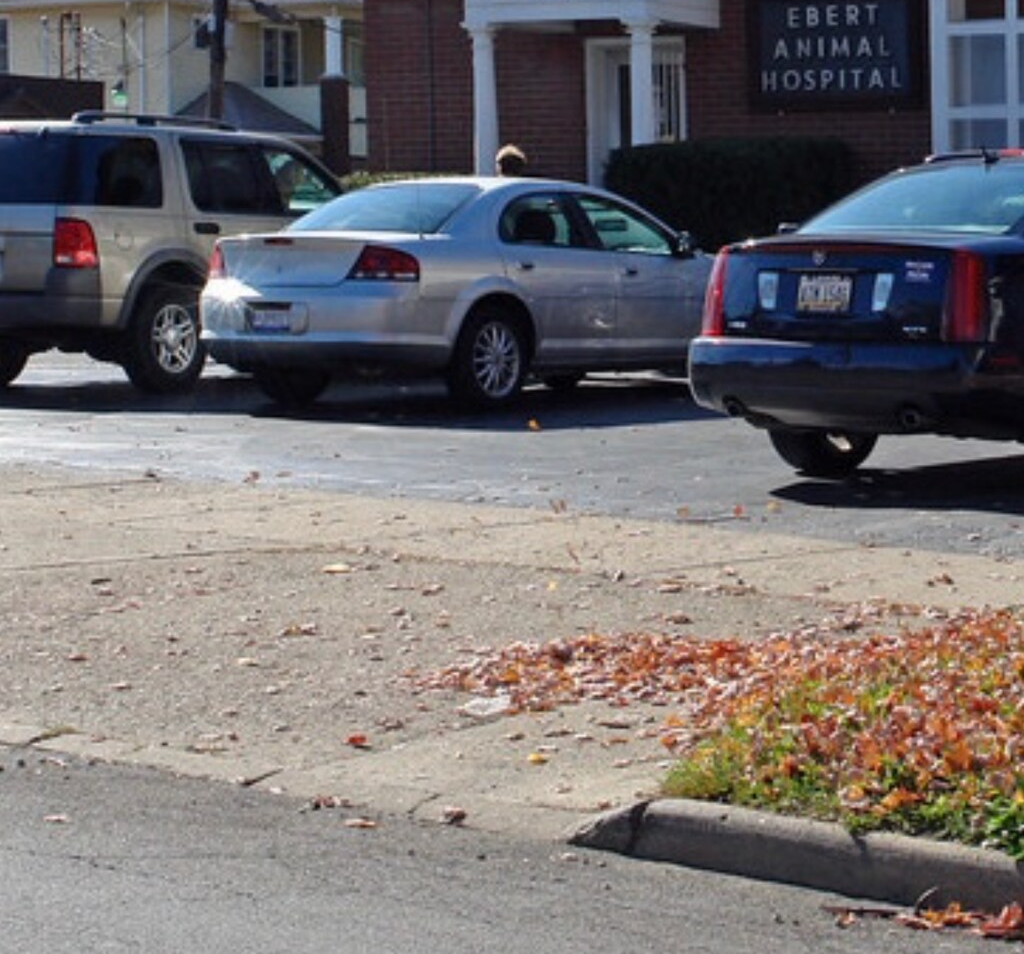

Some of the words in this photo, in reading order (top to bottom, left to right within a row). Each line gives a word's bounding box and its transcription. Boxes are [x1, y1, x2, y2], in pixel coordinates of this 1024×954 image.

[786, 4, 879, 29] EBERT
[773, 34, 891, 59] ANIMAL
[760, 66, 902, 92] HOSPITAL
